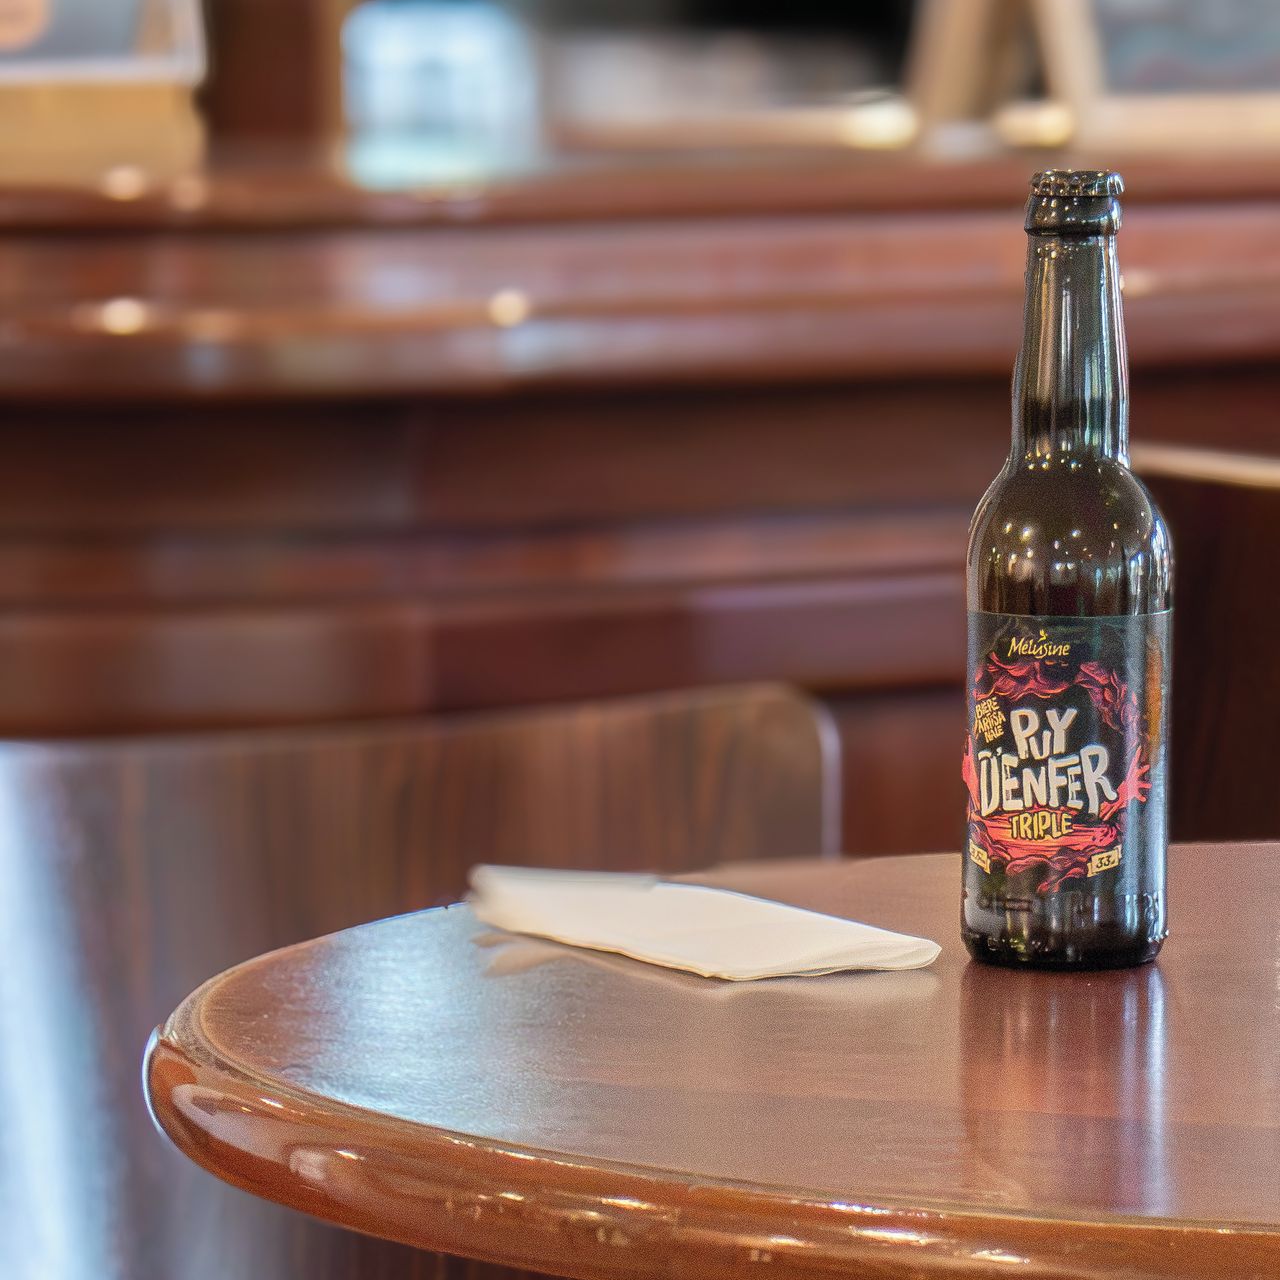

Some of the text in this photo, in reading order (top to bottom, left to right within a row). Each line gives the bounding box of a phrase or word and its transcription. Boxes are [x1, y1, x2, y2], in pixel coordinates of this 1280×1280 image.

[1007, 635, 1071, 659] Mélusine
[1009, 707, 1078, 760] PUY
[977, 744, 1118, 817] D'ENFER
[1010, 810, 1075, 840] TRIPLE
